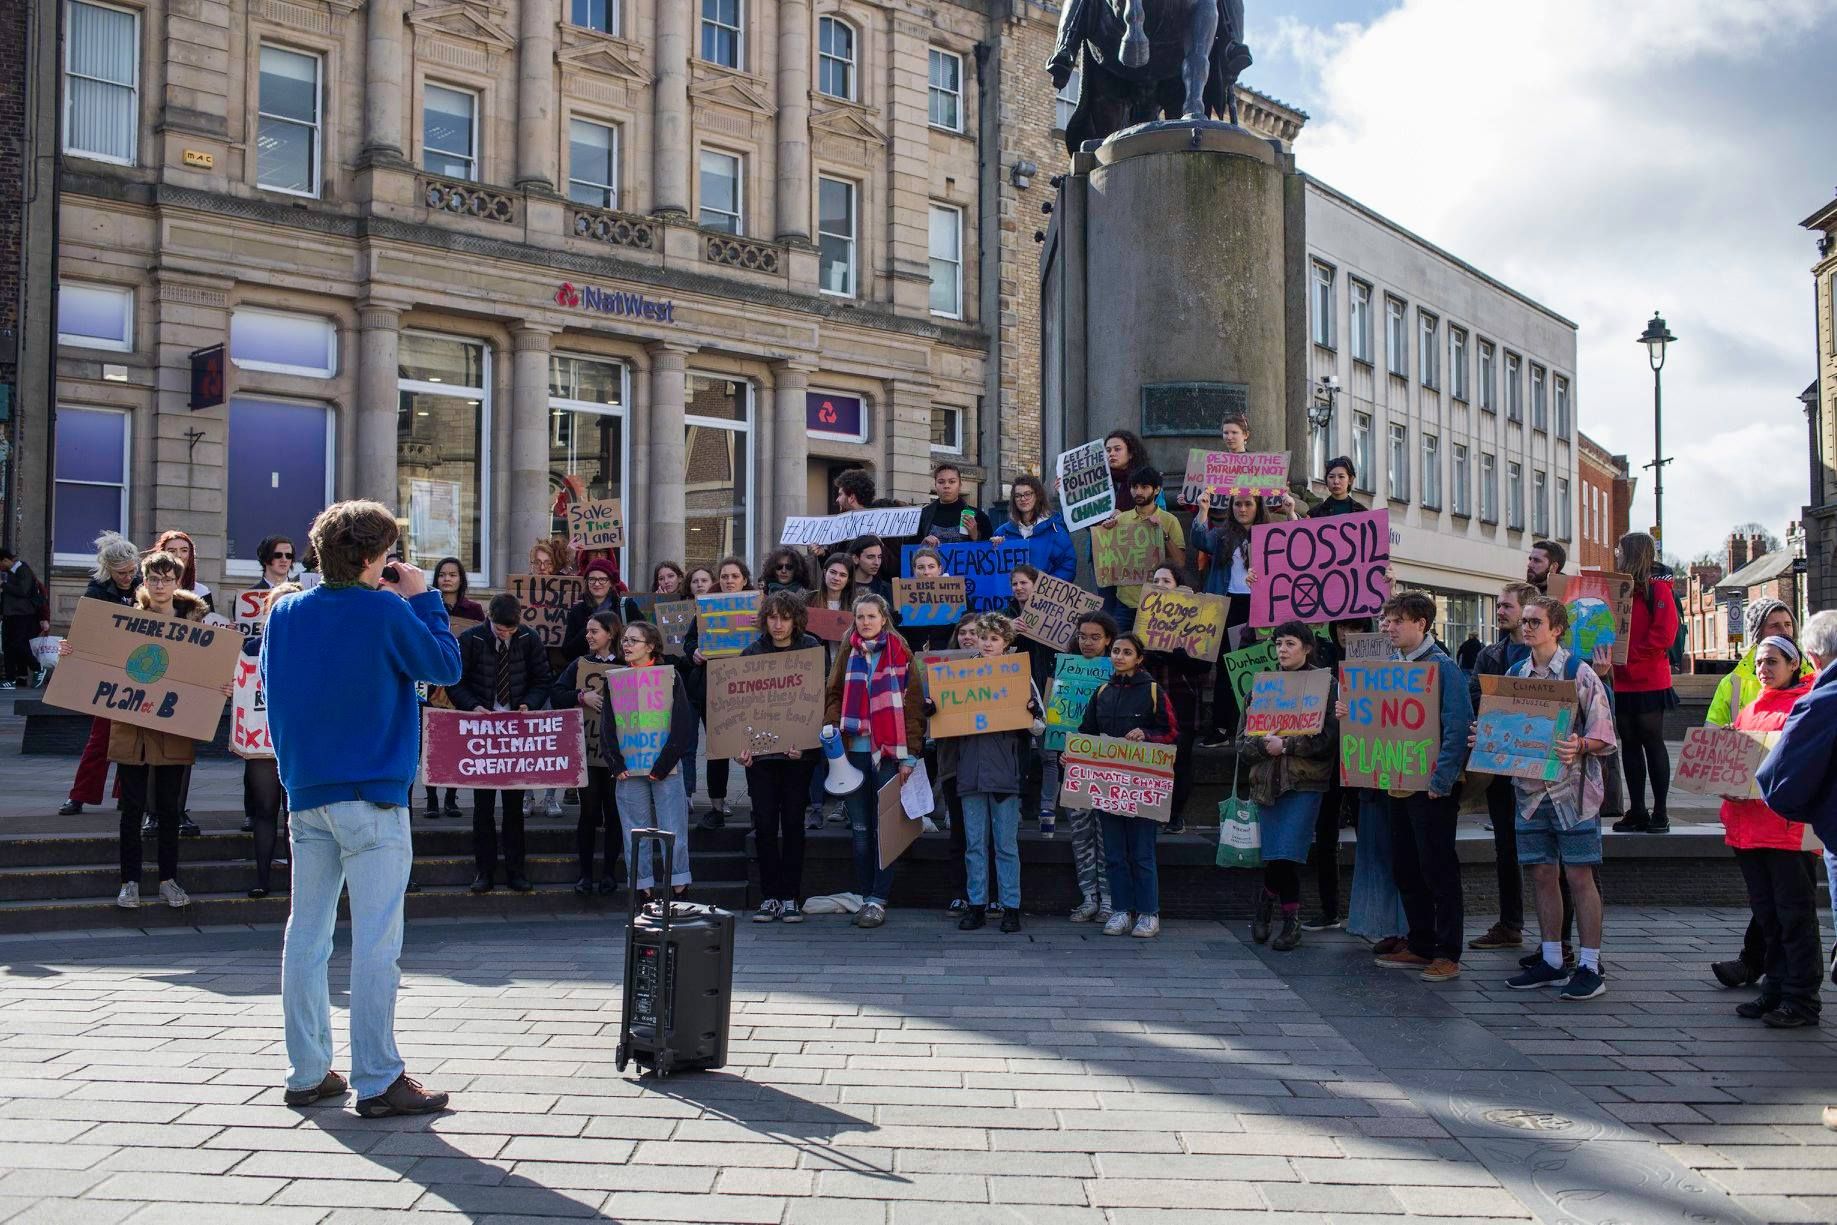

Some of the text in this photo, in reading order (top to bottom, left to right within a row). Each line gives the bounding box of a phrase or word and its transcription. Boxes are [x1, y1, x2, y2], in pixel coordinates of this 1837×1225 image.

[583, 286, 674, 323] NatWest
[1063, 445, 1090, 464] LET'S
[1206, 453, 1255, 464] DESTROY
[1258, 455, 1282, 465] THE
[1206, 464, 1285, 476] PATRIARCHY NOT
[1206, 474, 1236, 485] THE
[1066, 479, 1110, 506] CLIMATE
[1071, 494, 1112, 524] CHANGE
[585, 521, 610, 532] The
[1096, 526, 1129, 548] WE
[1098, 547, 1147, 568] HAVE
[1264, 519, 1389, 575] FOSSIL
[940, 549, 994, 576] YEARS
[513, 577, 584, 608] I USED
[916, 582, 935, 591] RISE
[939, 582, 961, 591] WITH
[1037, 576, 1102, 611] BEFORE THE
[1269, 565, 1386, 622] FOOLS
[908, 592, 964, 604] SEA LEVELS
[1030, 595, 1065, 619] WATER
[1140, 591, 1198, 623] Change
[1022, 609, 1039, 626] TOO
[112, 614, 164, 638] THERE
[164, 622, 189, 641] IS
[188, 627, 215, 647] NO
[1179, 621, 1216, 637] you
[1348, 639, 1384, 658] WHAT
[742, 659, 777, 674] sure
[784, 654, 813, 671] the
[1000, 662, 1021, 673] no
[1226, 652, 1268, 672] Durham
[610, 669, 666, 691] WHAT
[728, 673, 803, 695] DINOSAUR'S
[1056, 685, 1070, 695] IS
[1512, 681, 1555, 692] CLIMATE
[156, 691, 178, 718] B
[647, 690, 665, 711] IS
[711, 686, 822, 713] thought they had
[713, 708, 815, 735] more time too!
[975, 713, 988, 731] B
[1349, 696, 1425, 730] IS NO
[459, 719, 519, 735] MAKE
[524, 717, 563, 733] THE
[467, 735, 557, 755] CLIMATE
[1691, 729, 1755, 750] CLIMATE
[1343, 734, 1434, 776] PLANET
[1682, 743, 1748, 767] CHANGE
[458, 756, 569, 776] GREAT AGAIN
[1678, 762, 1749, 785] AFFECTS
[1068, 765, 1174, 792] CLIMATE CHANGE
[1378, 773, 1391, 789] B
[1065, 780, 1168, 806] IS A RACIST
[1092, 796, 1138, 813] ISSUE
